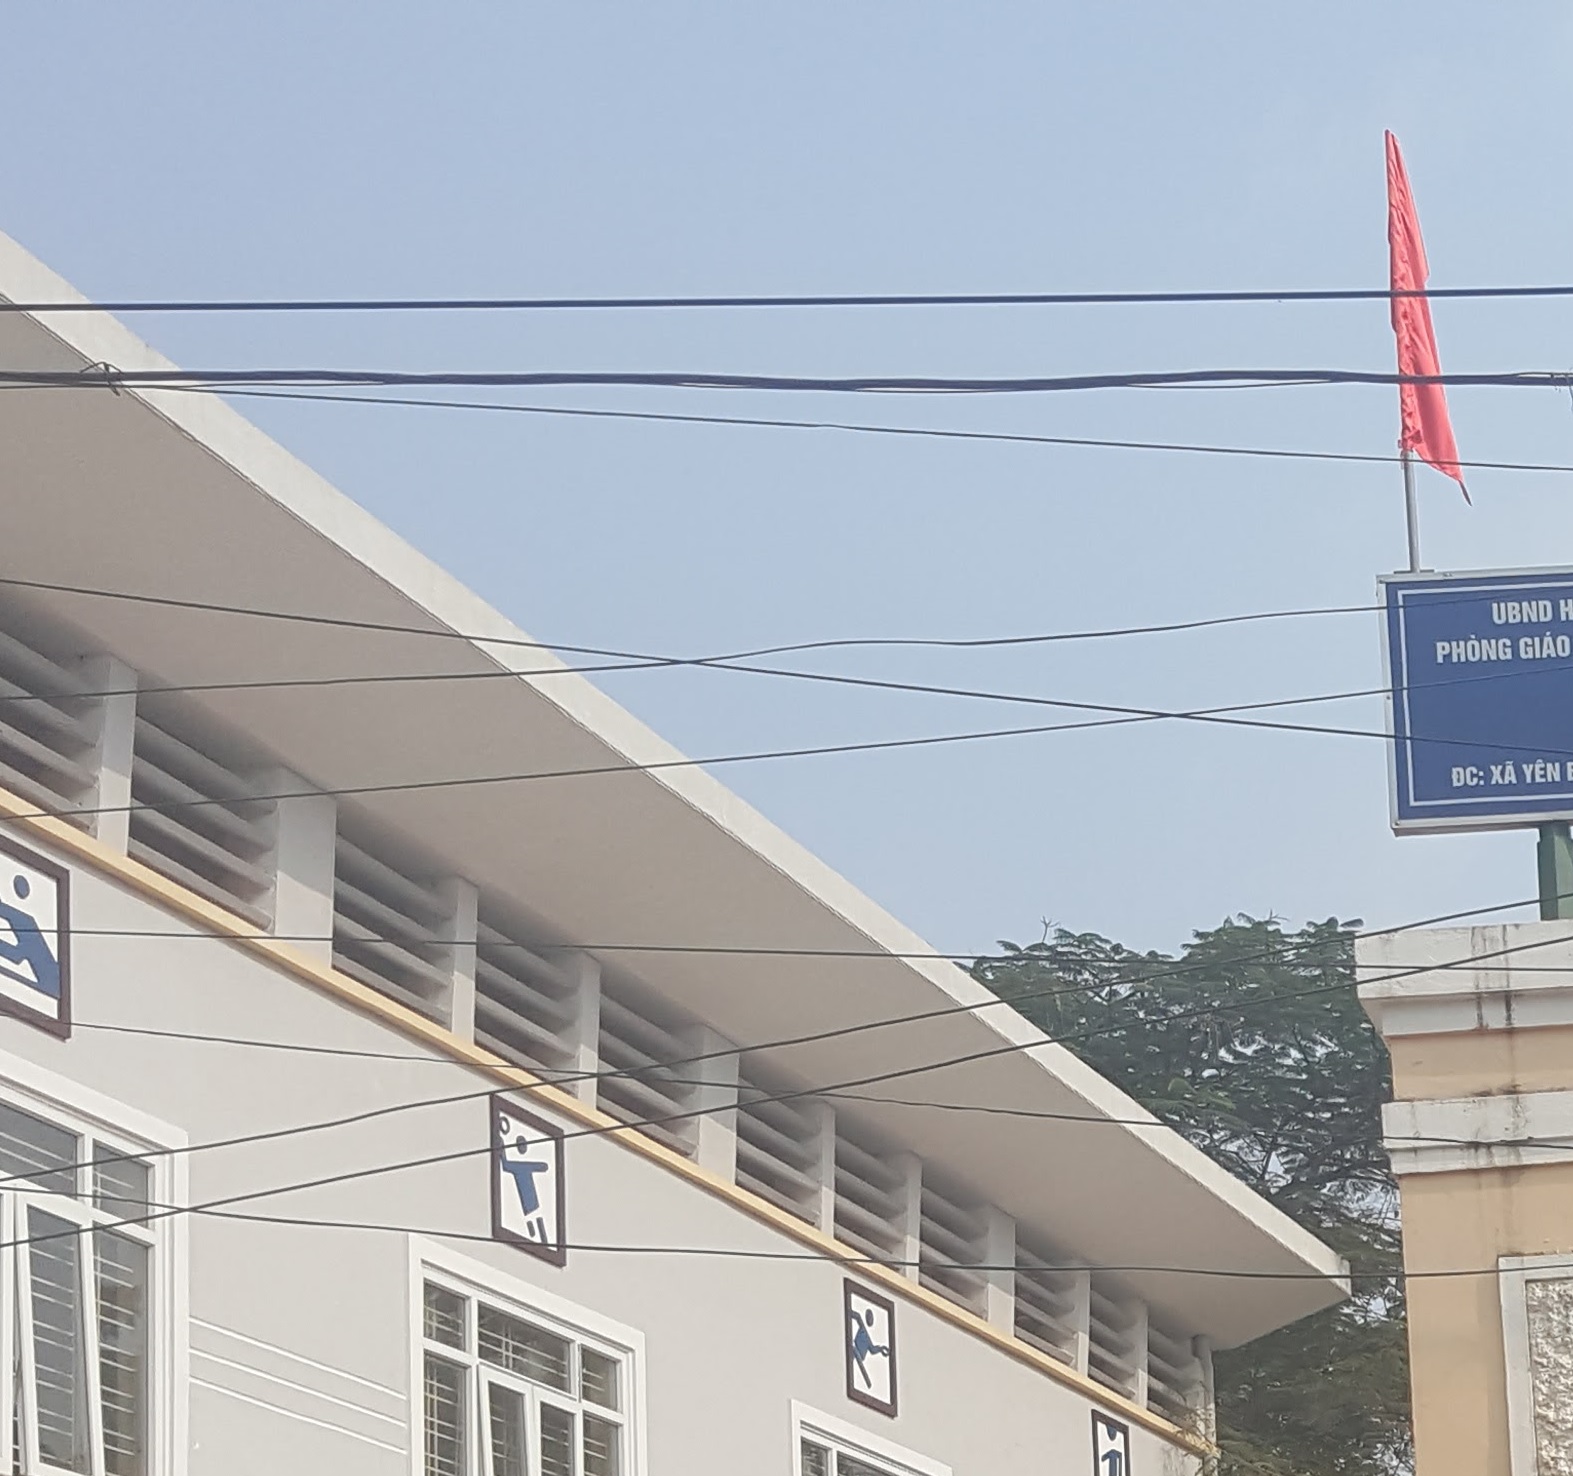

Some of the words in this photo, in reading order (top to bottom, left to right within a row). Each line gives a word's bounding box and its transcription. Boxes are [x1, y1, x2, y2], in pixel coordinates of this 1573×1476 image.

[1491, 600, 1553, 625] UBND
[1436, 634, 1512, 663] PHÒNG
[1519, 631, 1571, 660] GIÁO
[1451, 766, 1485, 787] ĐC:
[1489, 760, 1518, 785] XÃ
[1522, 758, 1561, 784] YÊN
